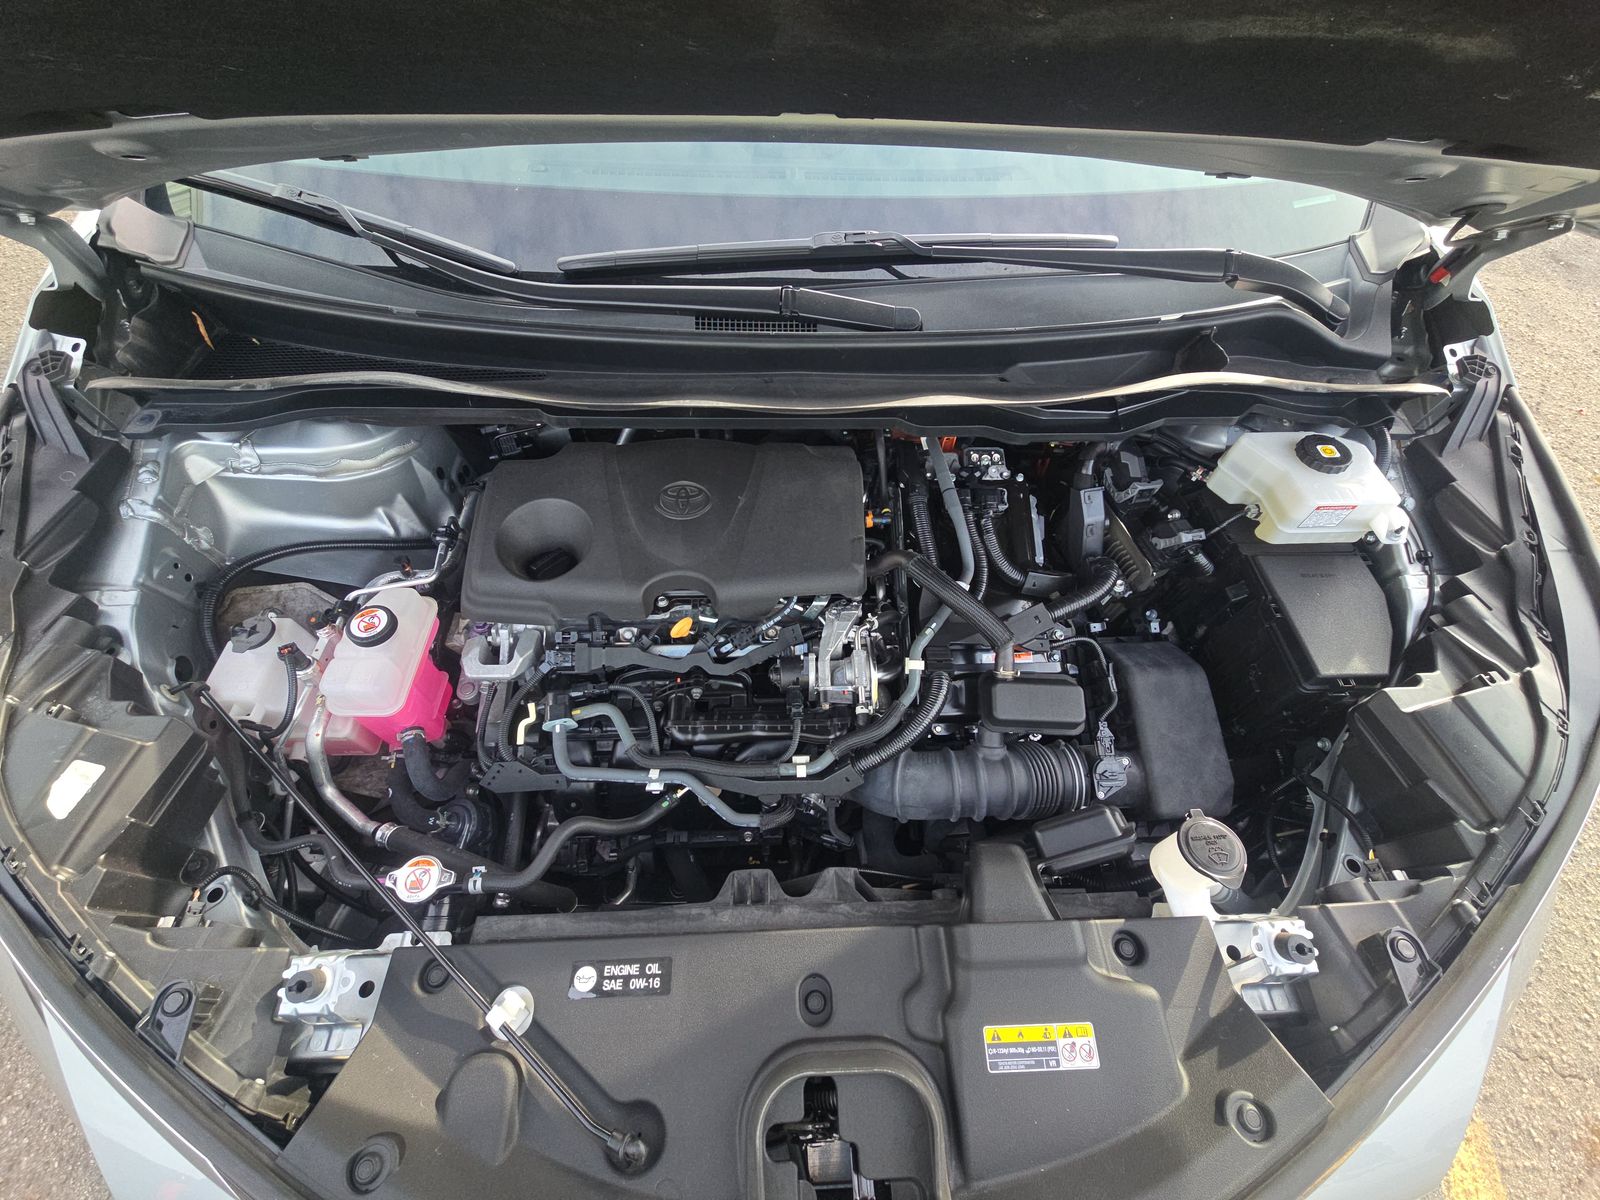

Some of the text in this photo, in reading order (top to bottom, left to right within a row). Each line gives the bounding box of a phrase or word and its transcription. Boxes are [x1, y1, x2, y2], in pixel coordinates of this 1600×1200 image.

[604, 963, 662, 976] ENGINE OIL
[602, 978, 661, 990] SAE 0W-16
